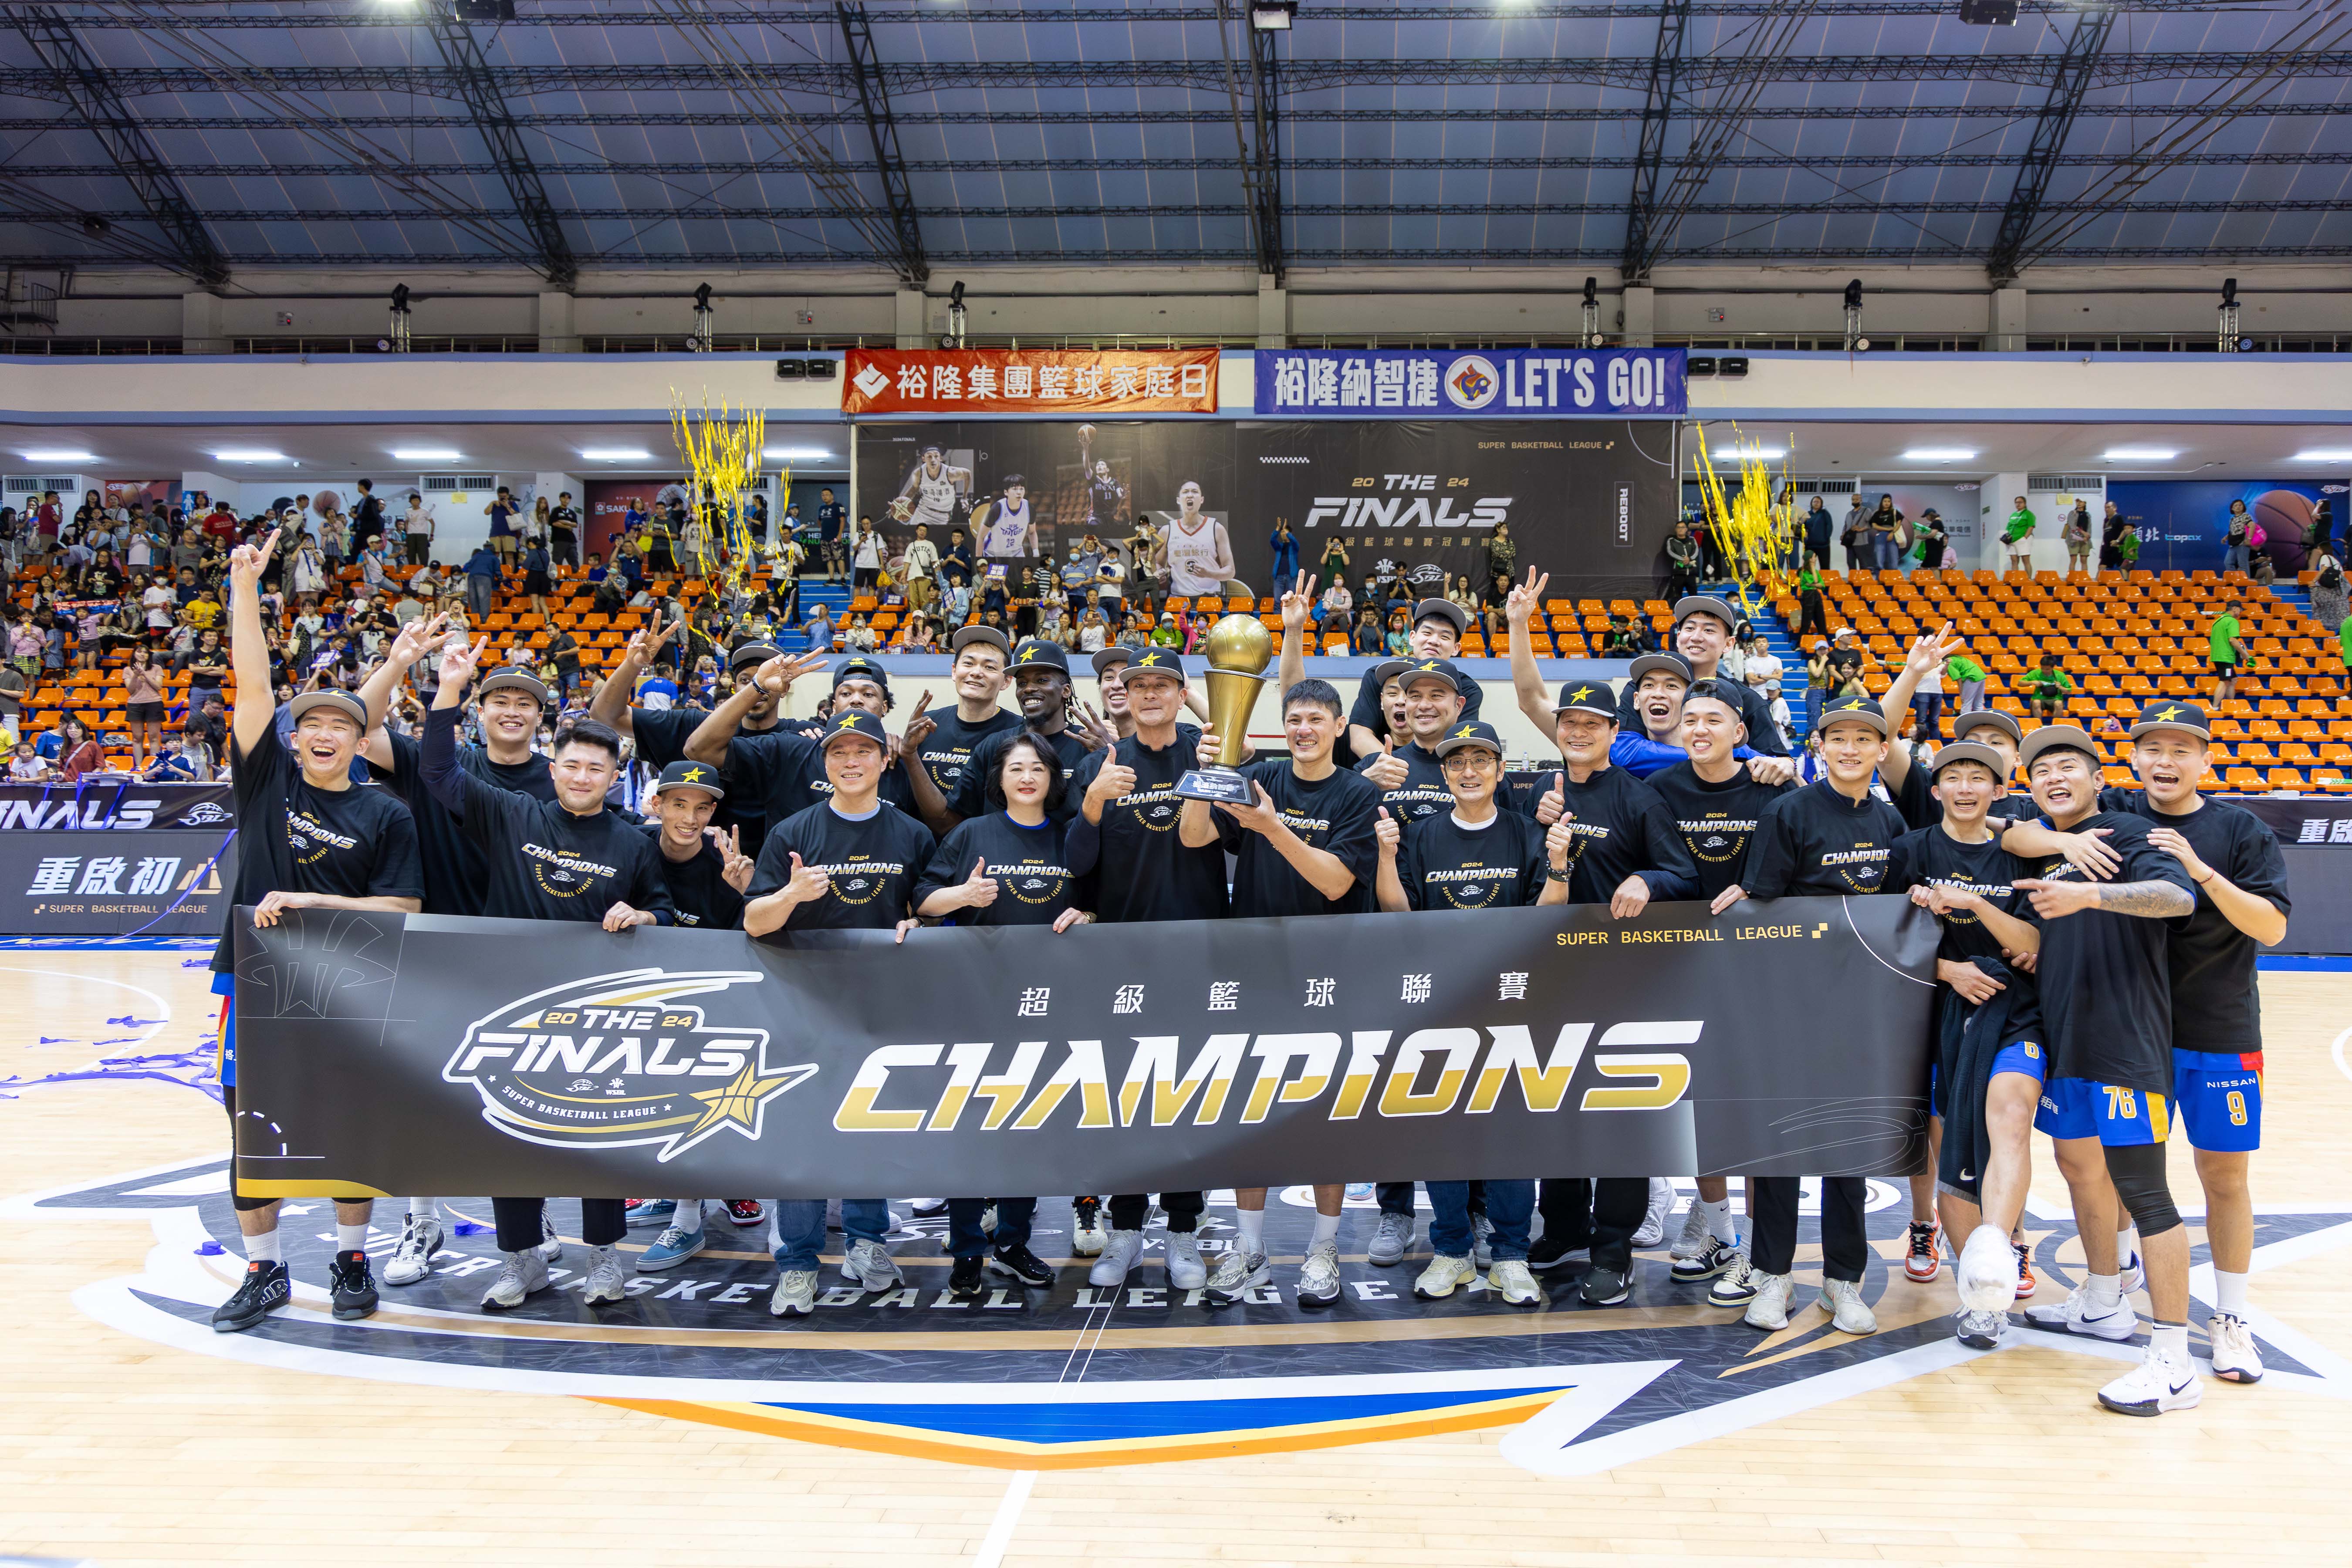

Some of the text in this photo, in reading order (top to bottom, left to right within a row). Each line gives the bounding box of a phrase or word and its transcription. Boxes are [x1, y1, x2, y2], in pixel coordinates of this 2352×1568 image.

[897, 364, 1207, 399] 裕隆集團籃球家庭日
[1274, 358, 1439, 406] 裕隆納智捷
[1506, 357, 1665, 407] LET'S GO!
[1352, 474, 1470, 490] 20 THE 24
[1305, 497, 1513, 527] FINALS
[1619, 487, 1629, 541] REBOOT
[922, 752, 971, 764] CHAMPI
[937, 779, 954, 790] BASKET
[1116, 789, 1182, 806] CHAMPI
[1382, 791, 1457, 804] CHAMPION
[1134, 809, 1146, 825] SUPER
[1276, 812, 1331, 831] MPIONS
[1397, 805, 1408, 821] SUPER
[287, 811, 358, 849] MPIONS
[521, 843, 617, 878] CHAMPIONS
[1686, 836, 1745, 862] SUPER BASKETBALL LEAGUE
[1821, 849, 1891, 865] CHAMPIO
[26, 856, 223, 895] 重啟初心
[535, 864, 544, 882] SUPER
[1425, 867, 1519, 883] CHAMPIONS
[829, 880, 841, 897] SUPER
[839, 895, 872, 905] BASKETBALL
[1005, 879, 1064, 904] SUPER BASKETBALL LEAGUE
[1442, 886, 1455, 903] SUPER
[1487, 882, 1500, 902] LEAGUE
[49, 905, 84, 913] SUPER
[91, 905, 159, 913] BASKETBALL
[1944, 913, 1977, 924] ASKETBALL
[1556, 925, 1803, 946] SUPER BASKETBALL LEAGUE
[1017, 972, 1530, 1017] 超級籃球聯賽
[544, 1009, 694, 1030] 20 THE 24
[459, 1032, 755, 1076] FINALS
[833, 1020, 1705, 1132] CHAMPIONS
[2207, 1077, 2257, 1088] NISSAN
[502, 1085, 656, 1120] SUPER BASKETBALL LEAGUE
[2102, 1085, 2137, 1120] 76
[2227, 1091, 2248, 1126] 9
